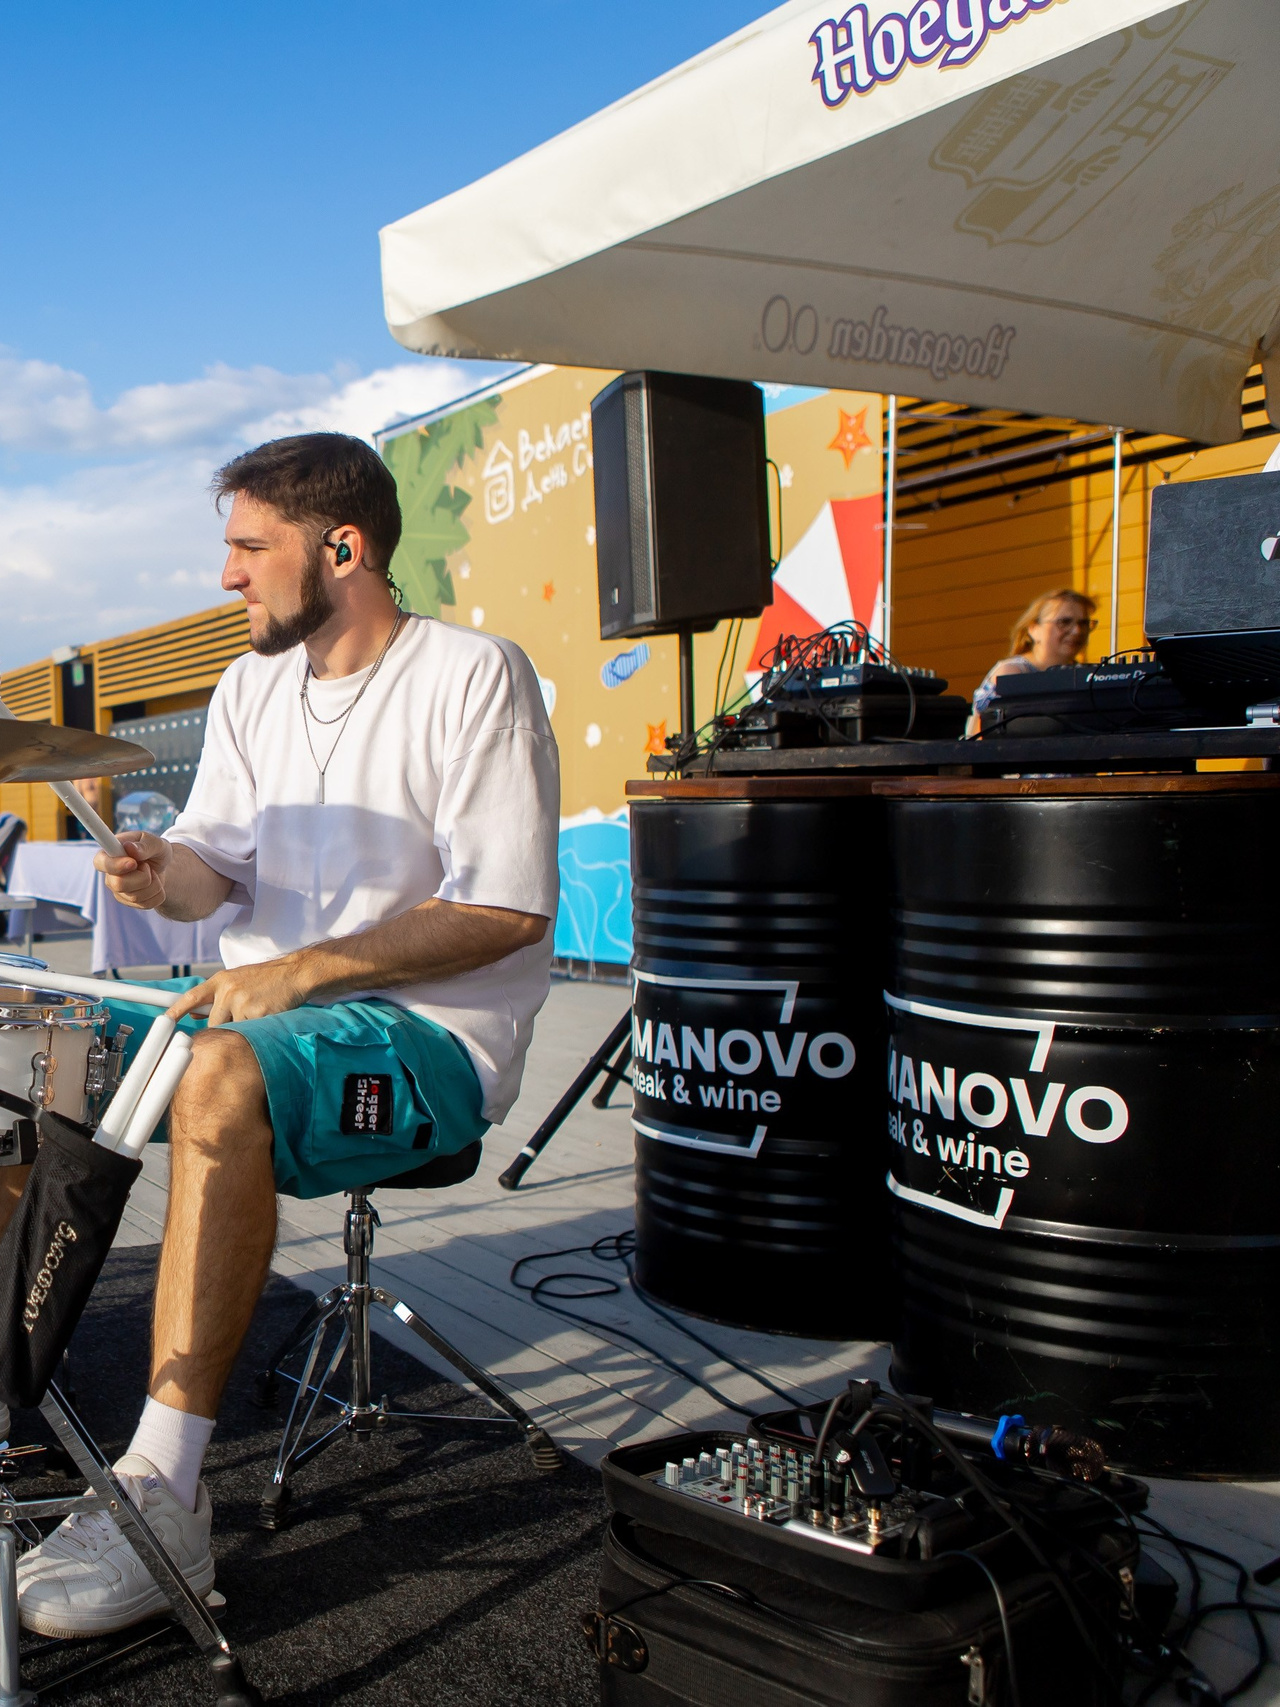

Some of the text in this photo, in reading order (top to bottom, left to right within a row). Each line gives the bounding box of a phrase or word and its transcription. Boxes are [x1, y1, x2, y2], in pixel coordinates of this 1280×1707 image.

[631, 1014, 856, 1079] MANOVO
[672, 1073, 692, 1105] &
[699, 1080, 782, 1113] wine
[911, 1118, 931, 1157] &
[936, 1132, 1030, 1178] wine
